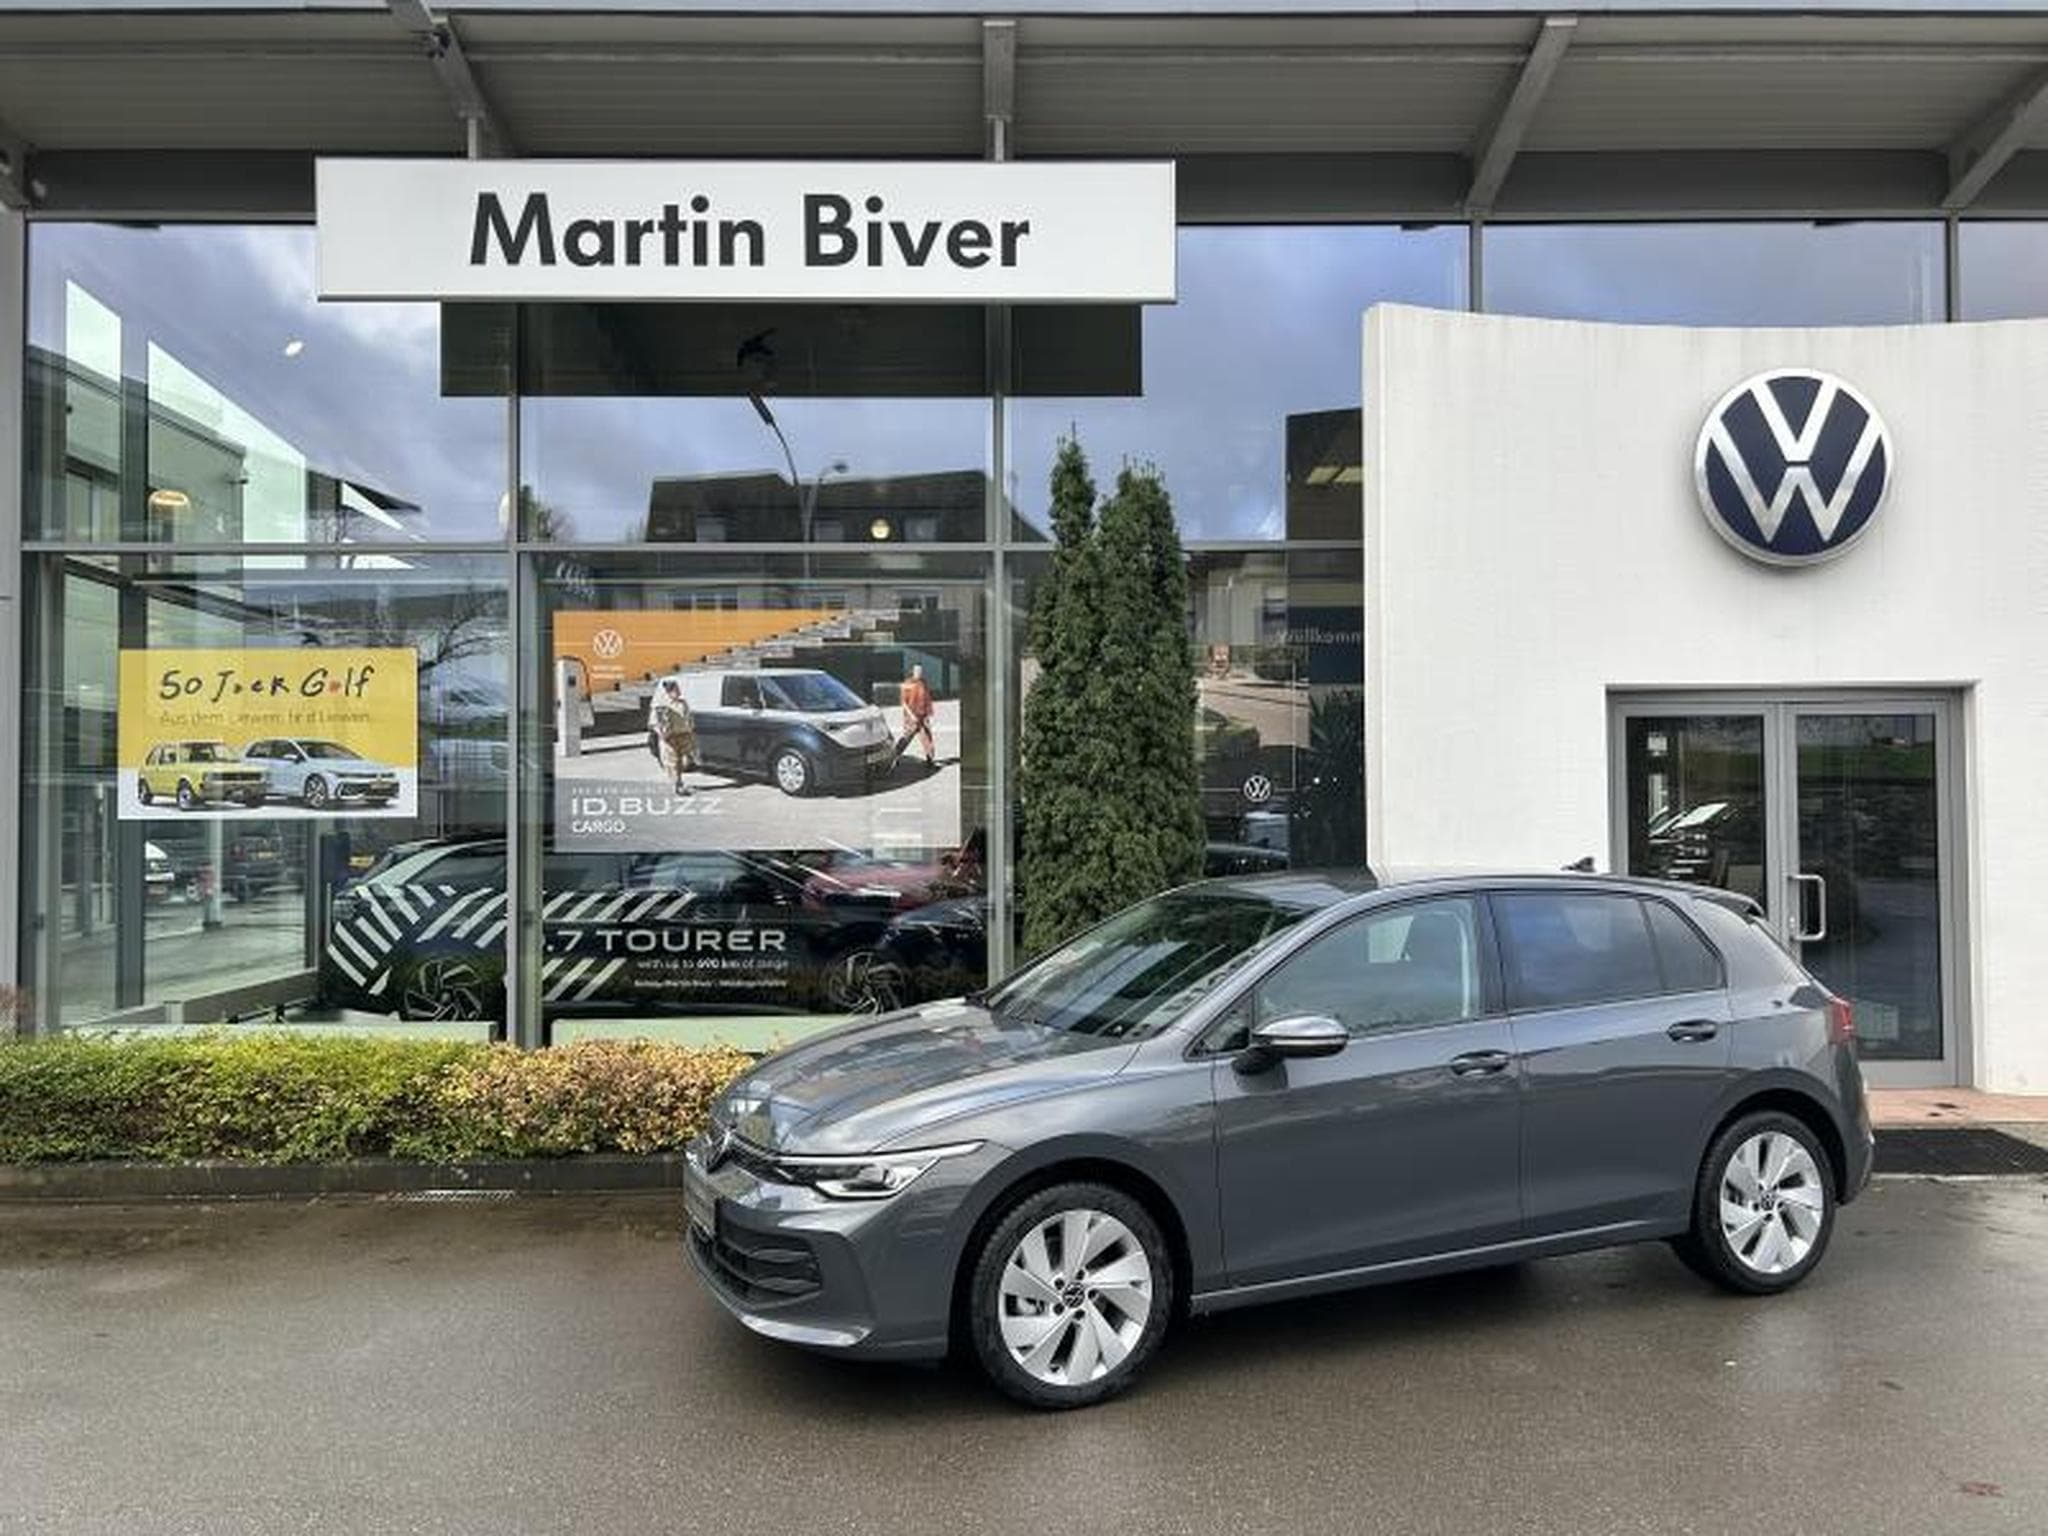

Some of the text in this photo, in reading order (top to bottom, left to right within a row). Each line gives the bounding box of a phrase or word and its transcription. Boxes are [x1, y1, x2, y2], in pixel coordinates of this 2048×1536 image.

[470, 192, 1031, 269] Martin Biver
[596, 930, 786, 951] TOURER
